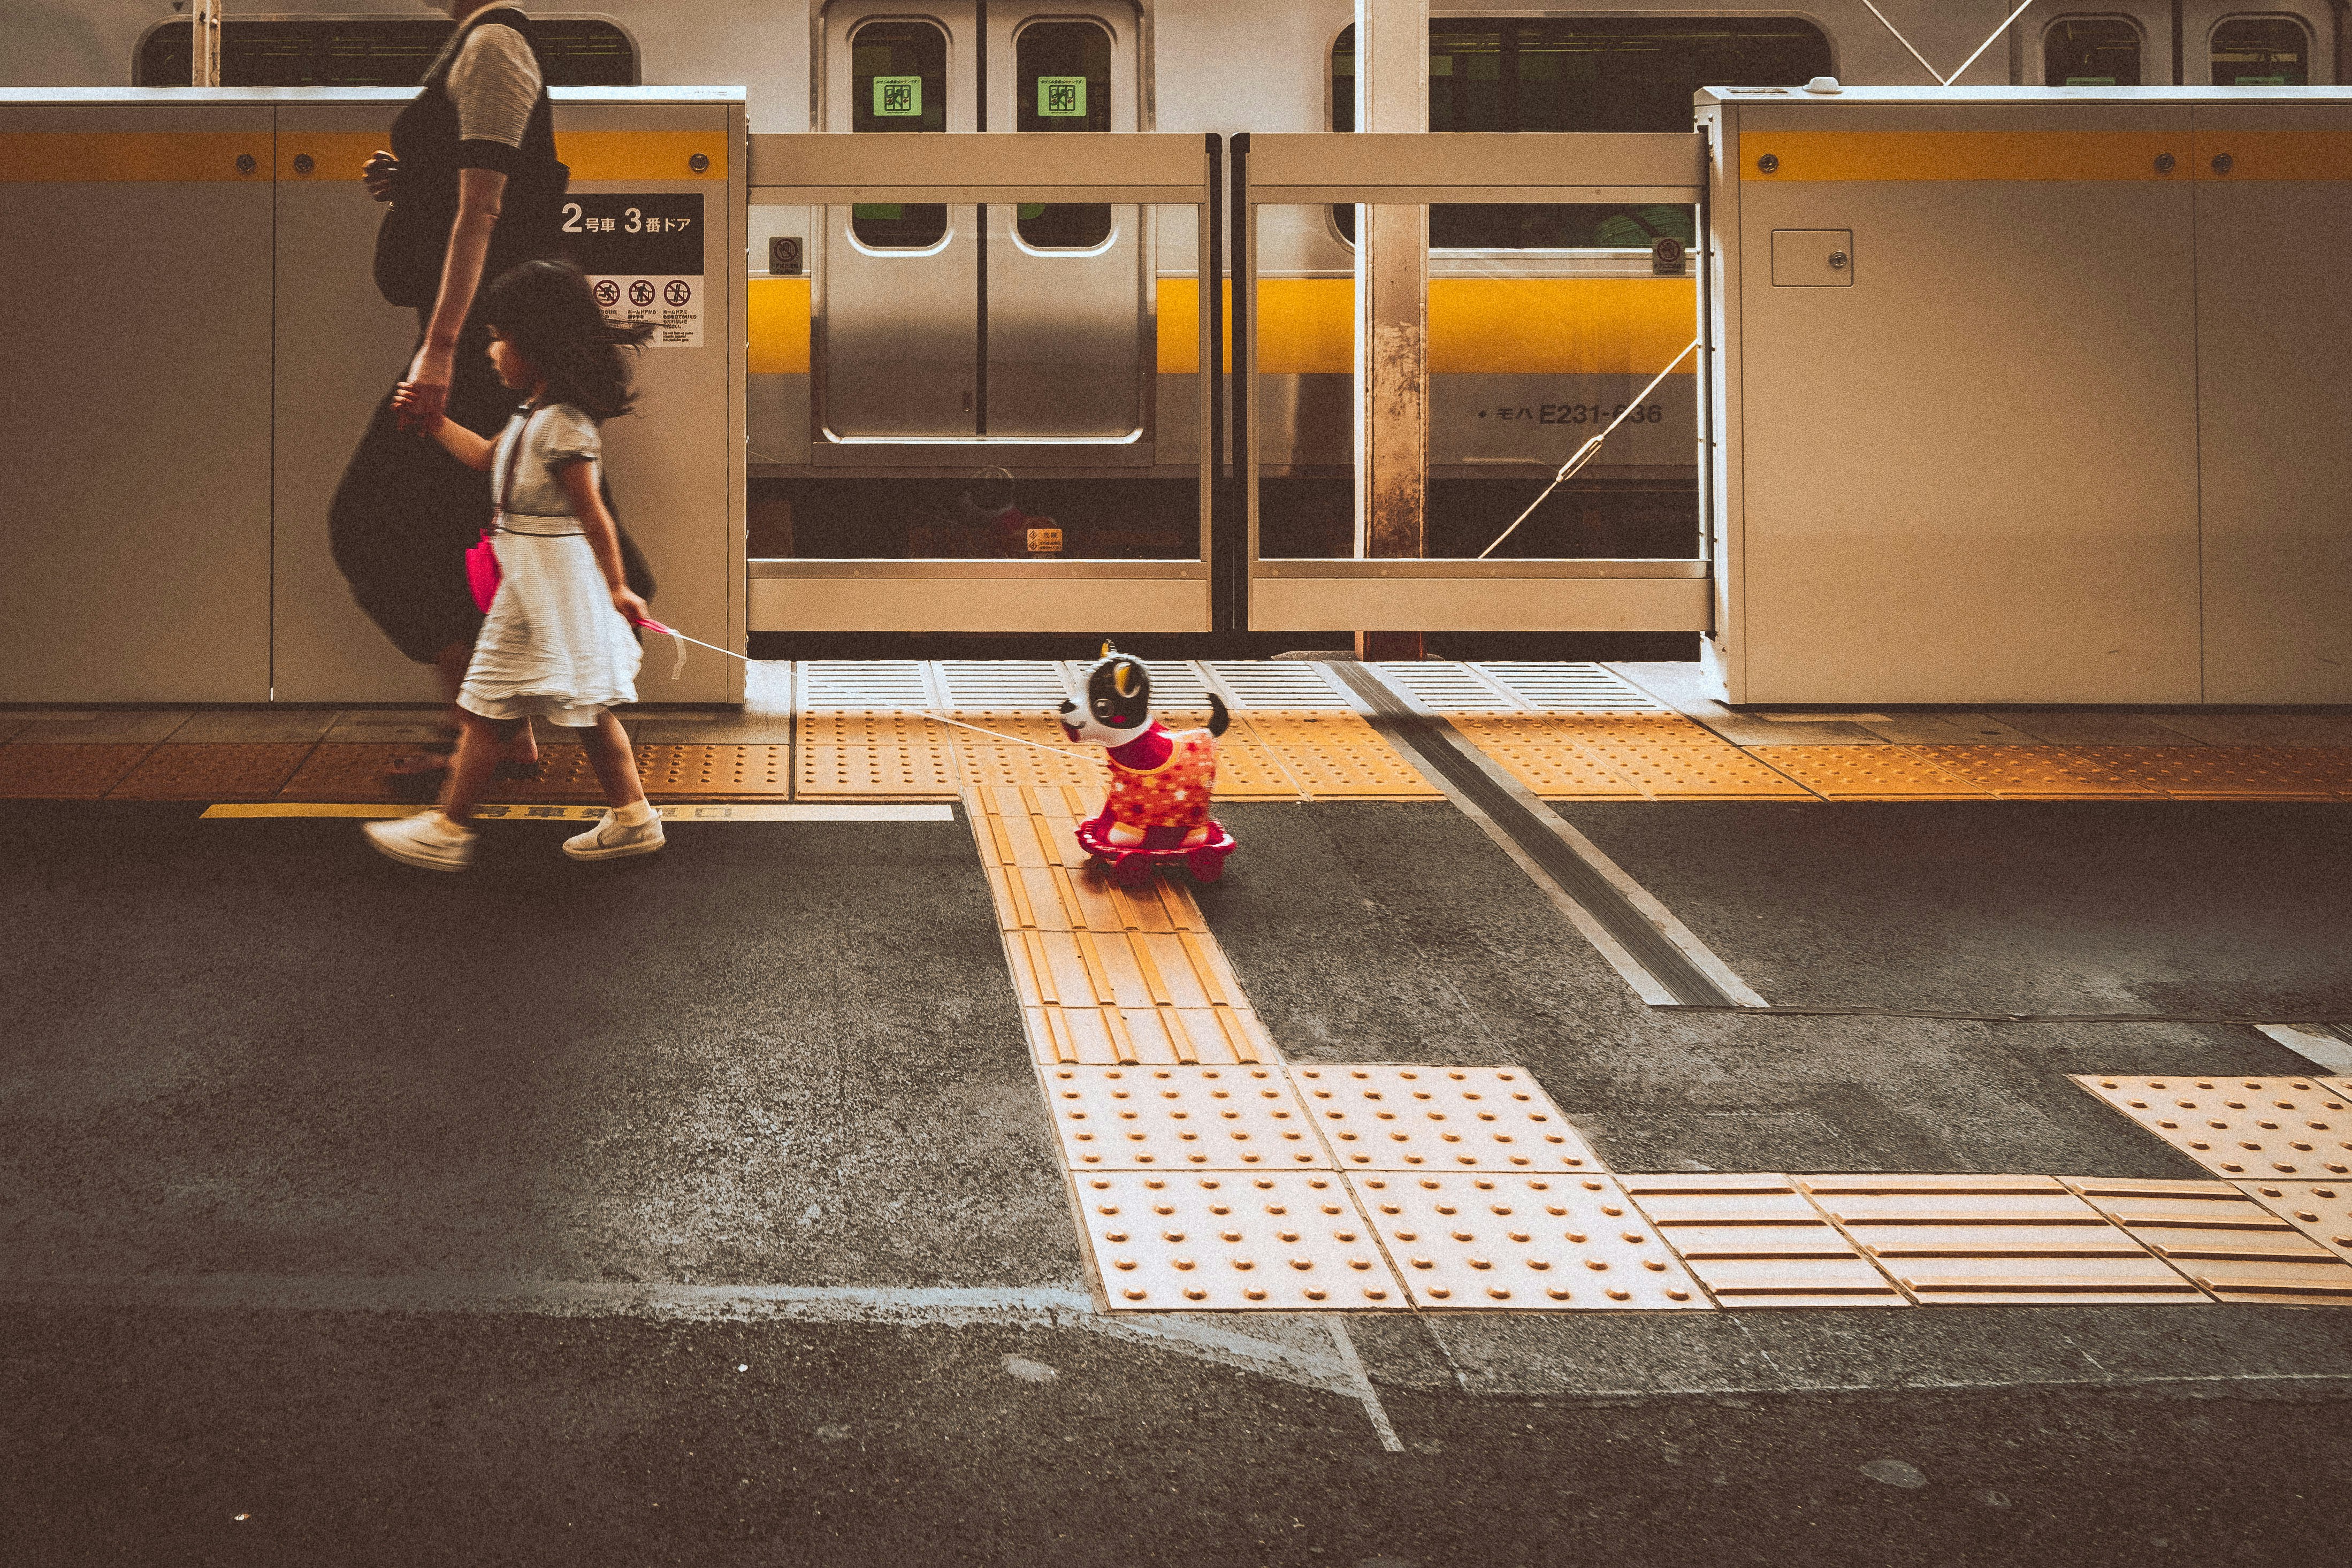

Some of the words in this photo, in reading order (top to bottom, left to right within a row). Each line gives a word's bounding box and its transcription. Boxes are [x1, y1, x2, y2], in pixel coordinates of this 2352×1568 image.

[562, 203, 615, 233] 2号車
[624, 208, 691, 233] 3番ドア
[1498, 408, 1533, 420] モハ
[1539, 404, 1662, 424] E231-636
